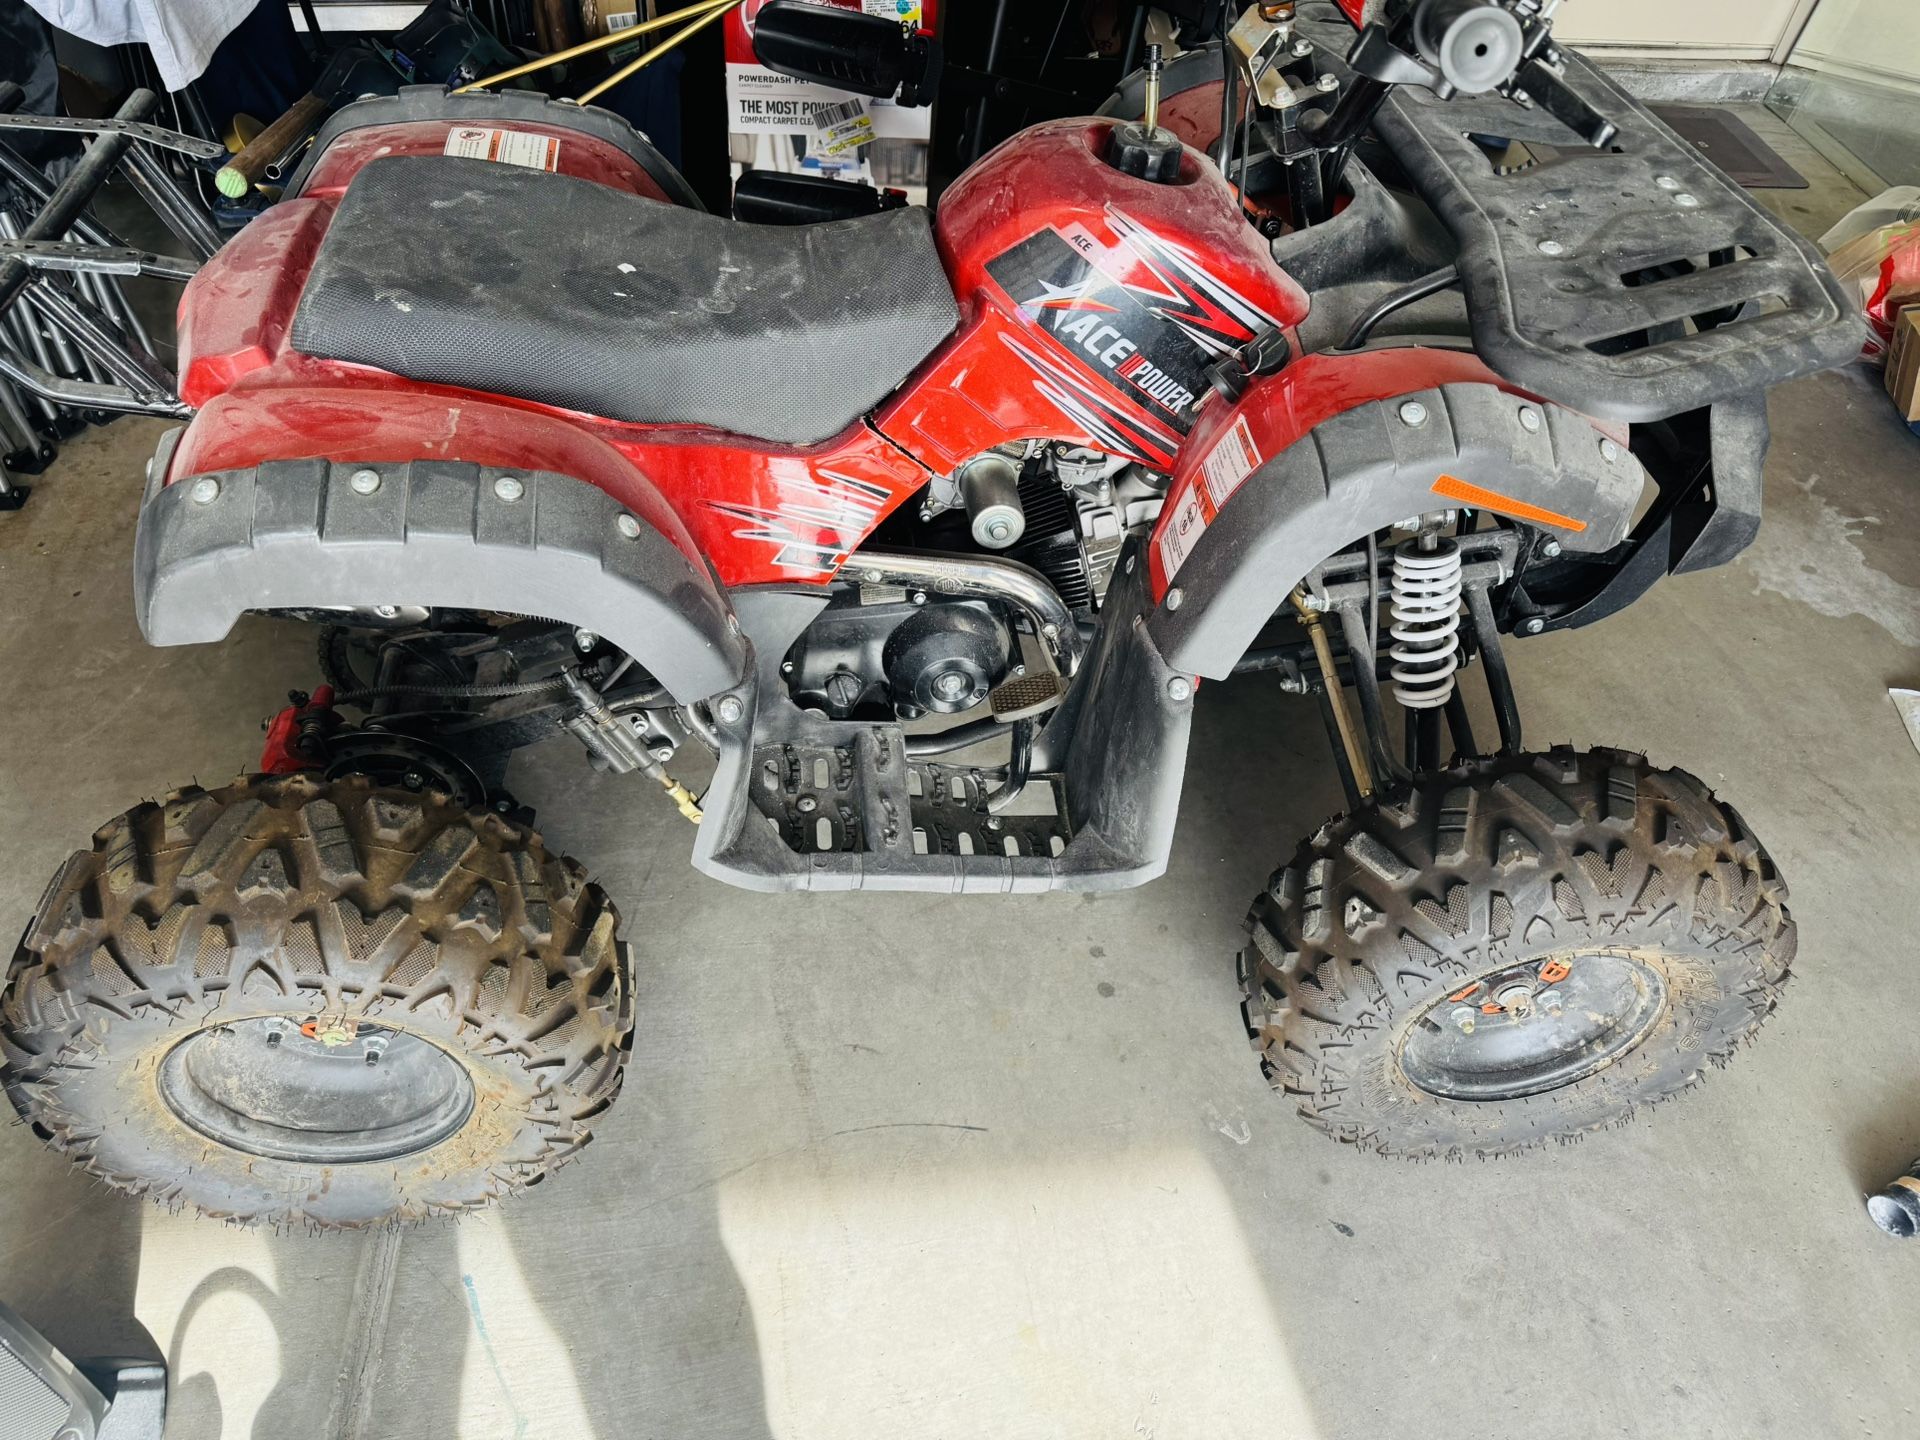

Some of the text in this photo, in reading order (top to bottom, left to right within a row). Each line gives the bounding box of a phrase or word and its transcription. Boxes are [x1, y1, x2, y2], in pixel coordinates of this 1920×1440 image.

[738, 74, 791, 84] POWERDASH
[740, 99, 838, 115] THE MOST POW
[740, 115, 771, 125] COMPACT
[772, 116, 798, 126] CARPET
[1070, 234, 1093, 252] ACE
[1060, 313, 1195, 414] ACE POWER
